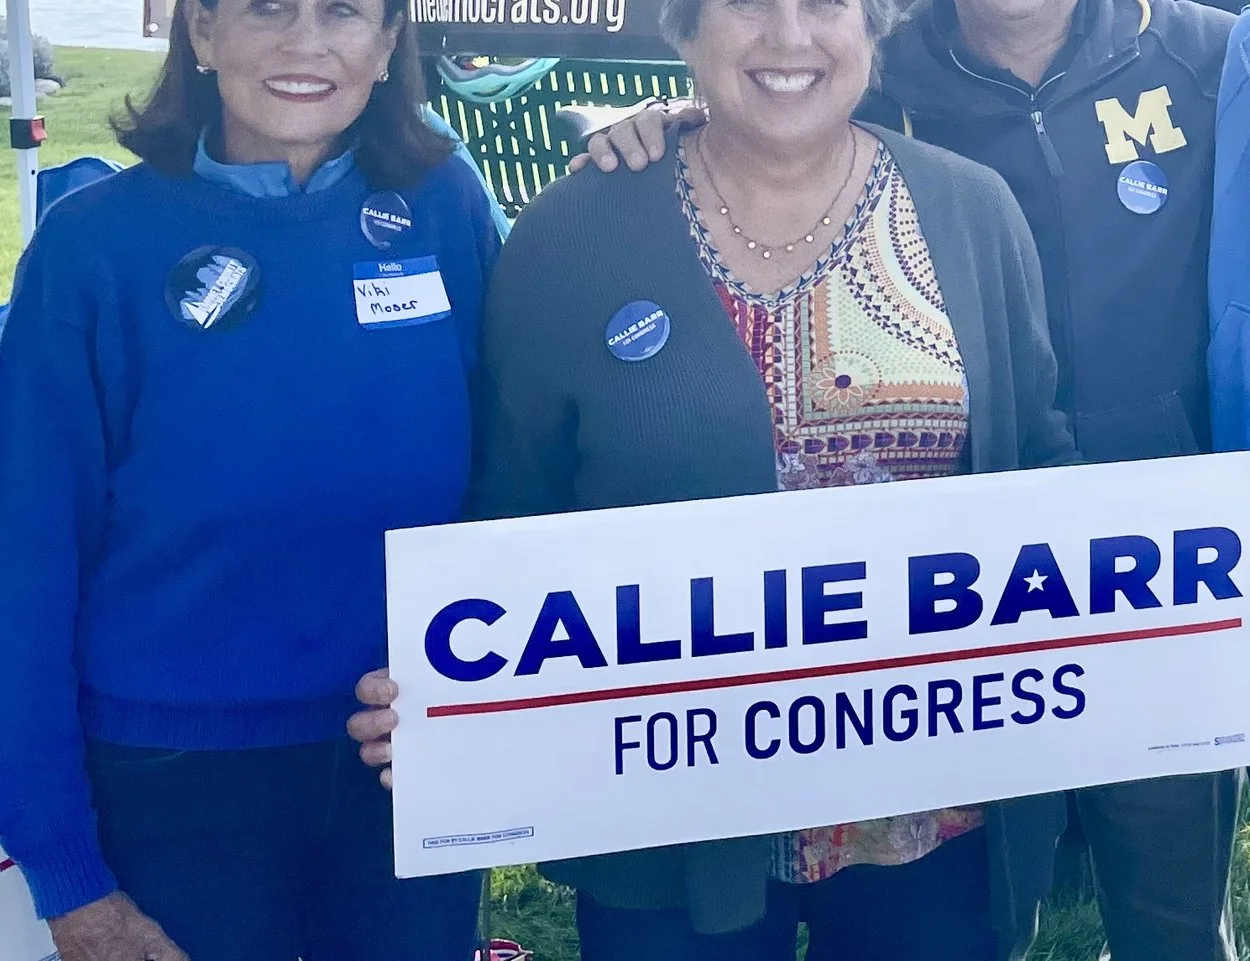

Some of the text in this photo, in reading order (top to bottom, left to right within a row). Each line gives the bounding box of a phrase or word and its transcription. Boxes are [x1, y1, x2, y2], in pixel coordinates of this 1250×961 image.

[1095, 85, 1188, 164] M
[1119, 176, 1146, 189] CALLIE
[608, 309, 664, 346] CALLIE BARR
[425, 526, 1244, 682] CALLIE BARR
[614, 663, 1088, 776] FOR CONGRESS
